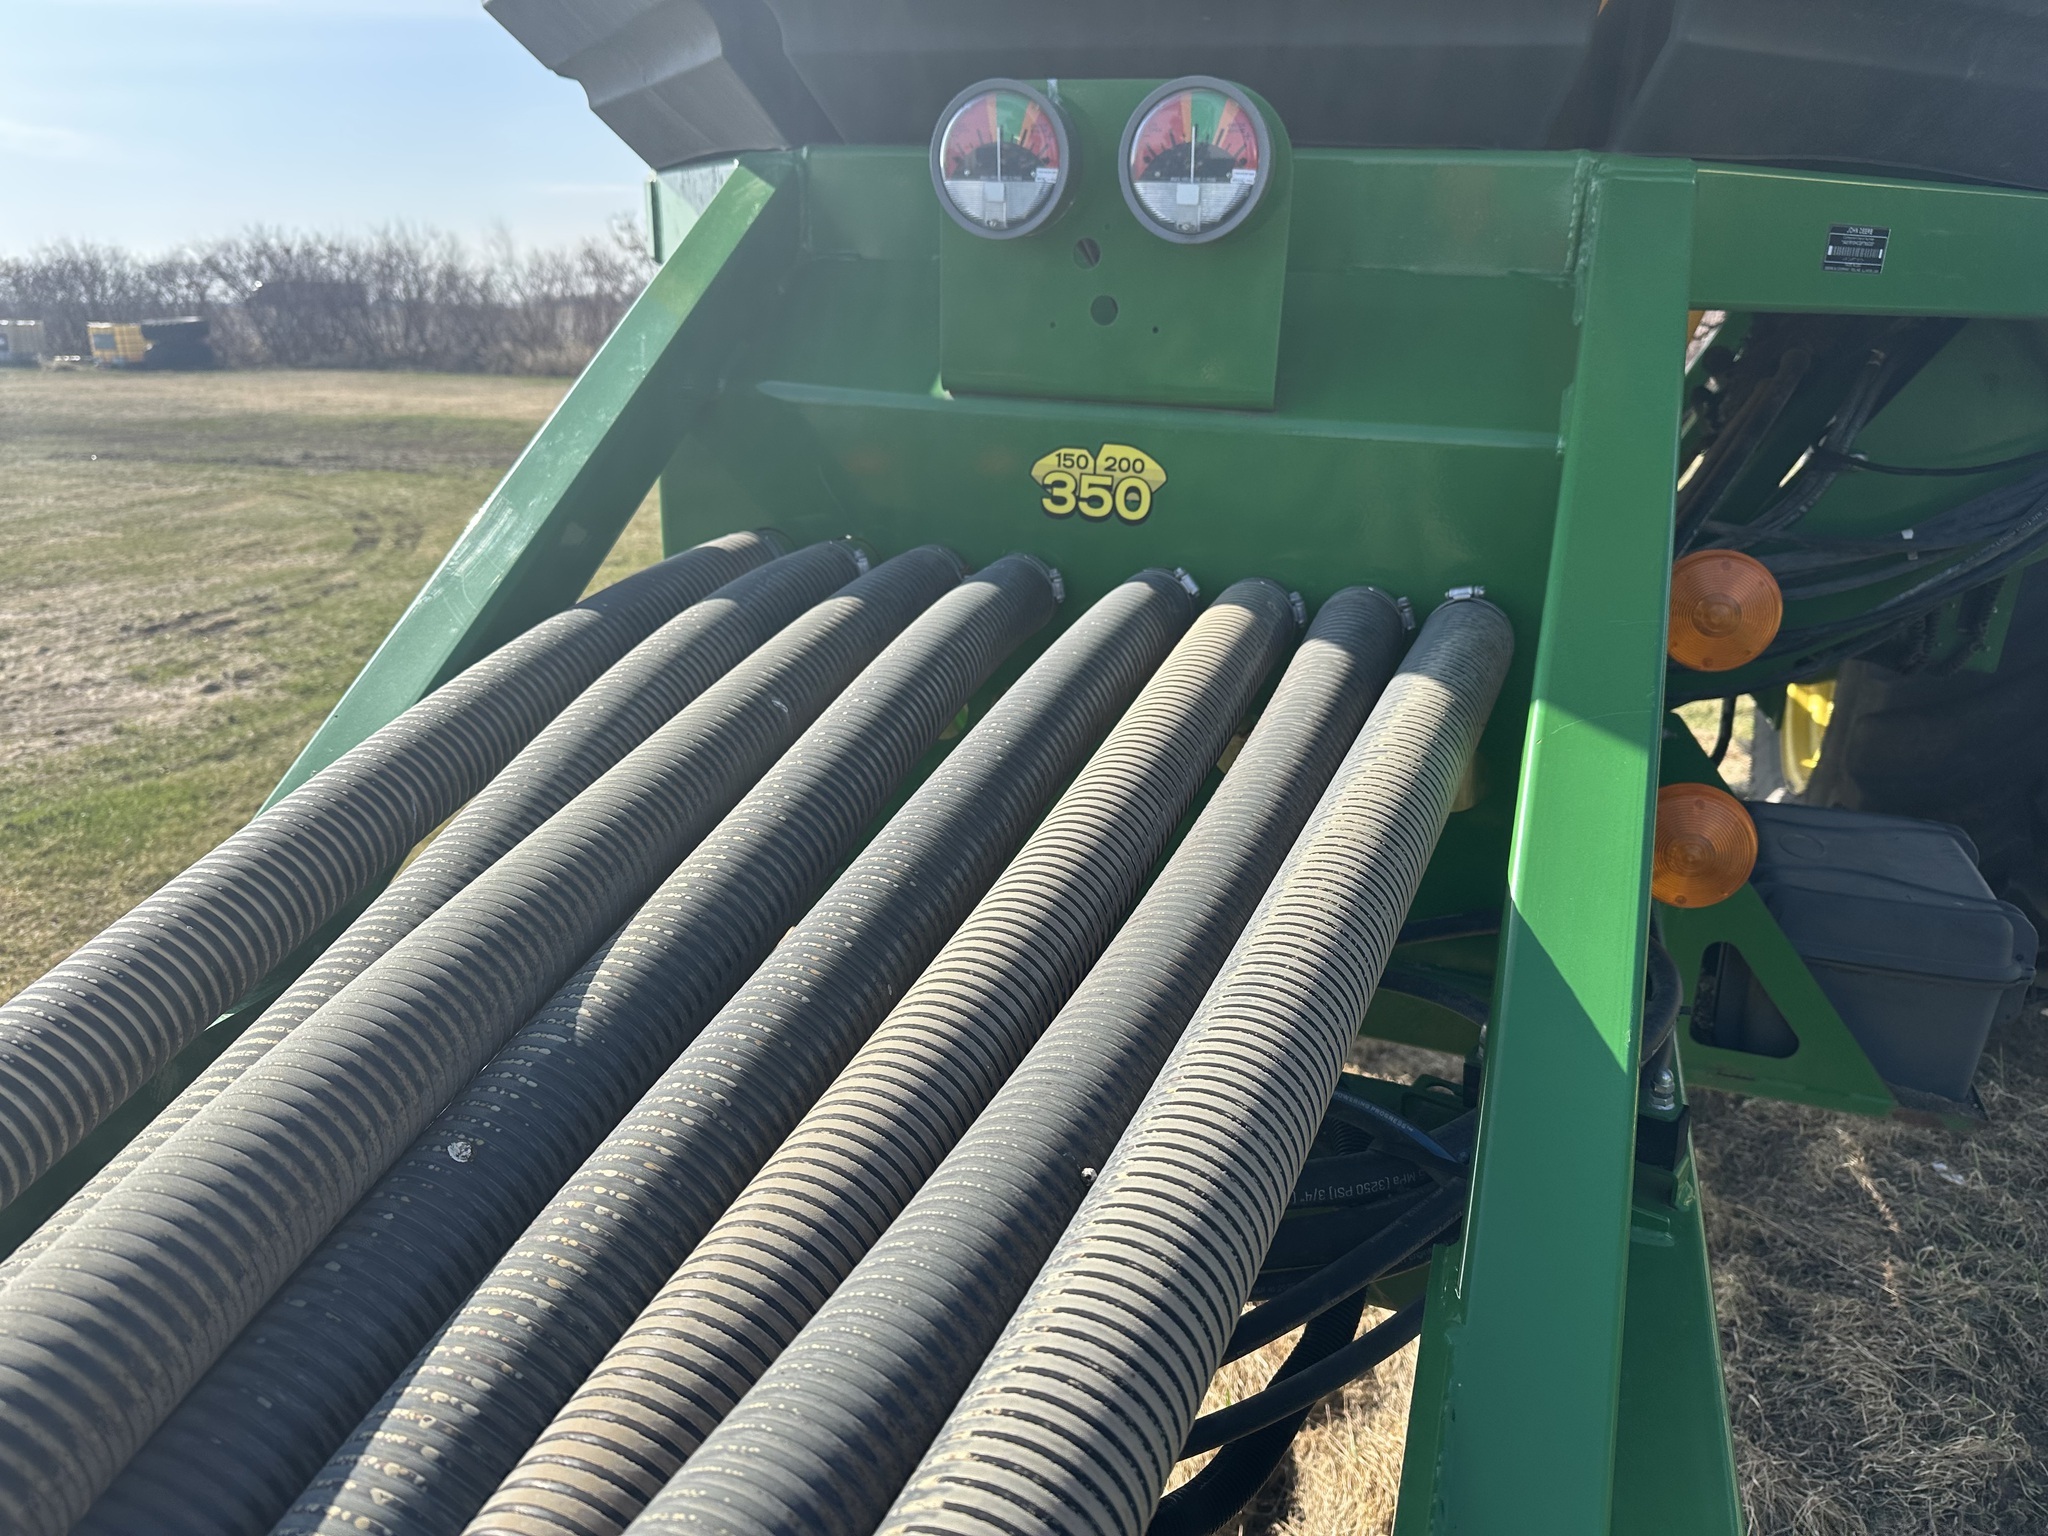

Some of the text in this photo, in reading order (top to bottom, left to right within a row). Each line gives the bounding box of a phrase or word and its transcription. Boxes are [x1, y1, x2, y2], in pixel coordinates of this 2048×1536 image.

[1055, 452, 1145, 474] 150 200
[1041, 470, 1152, 523] 350
[1333, 1090, 1370, 1110] POWERING
[1393, 1171, 1416, 1185] MPa
